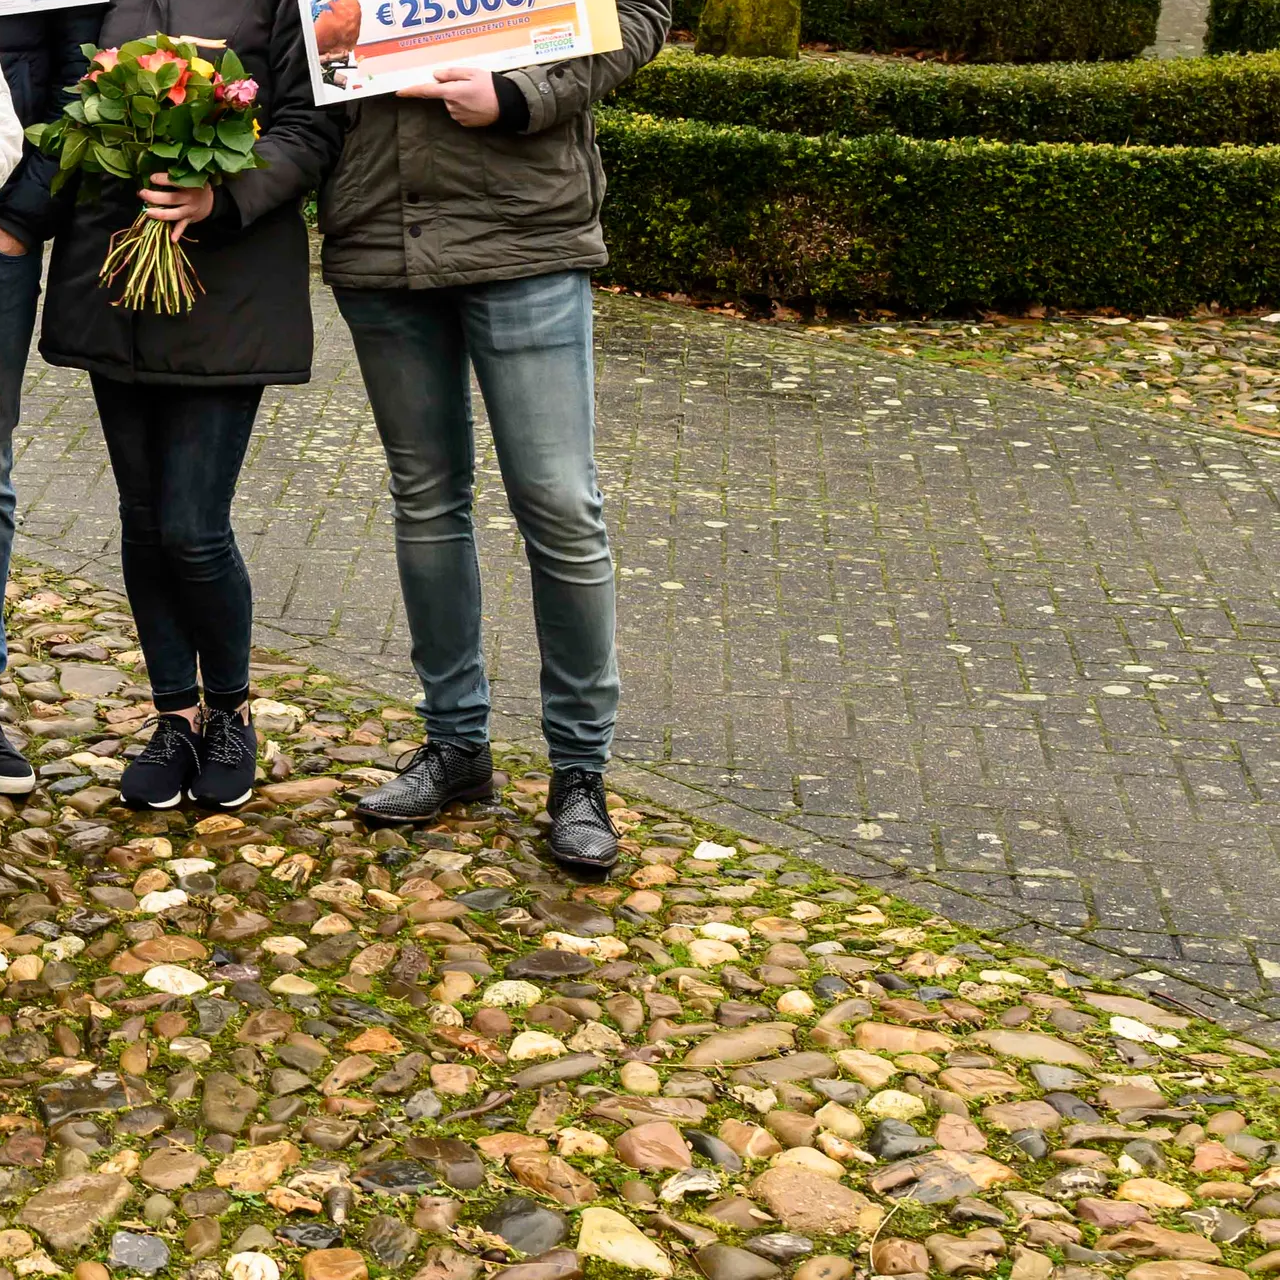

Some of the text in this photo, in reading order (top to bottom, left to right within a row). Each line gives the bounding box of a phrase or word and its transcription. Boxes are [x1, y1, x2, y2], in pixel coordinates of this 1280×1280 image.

[399, 16, 531, 48] VIJFENTWINTIGDUIZEND EURO
[534, 37, 573, 51] POSTCODE
